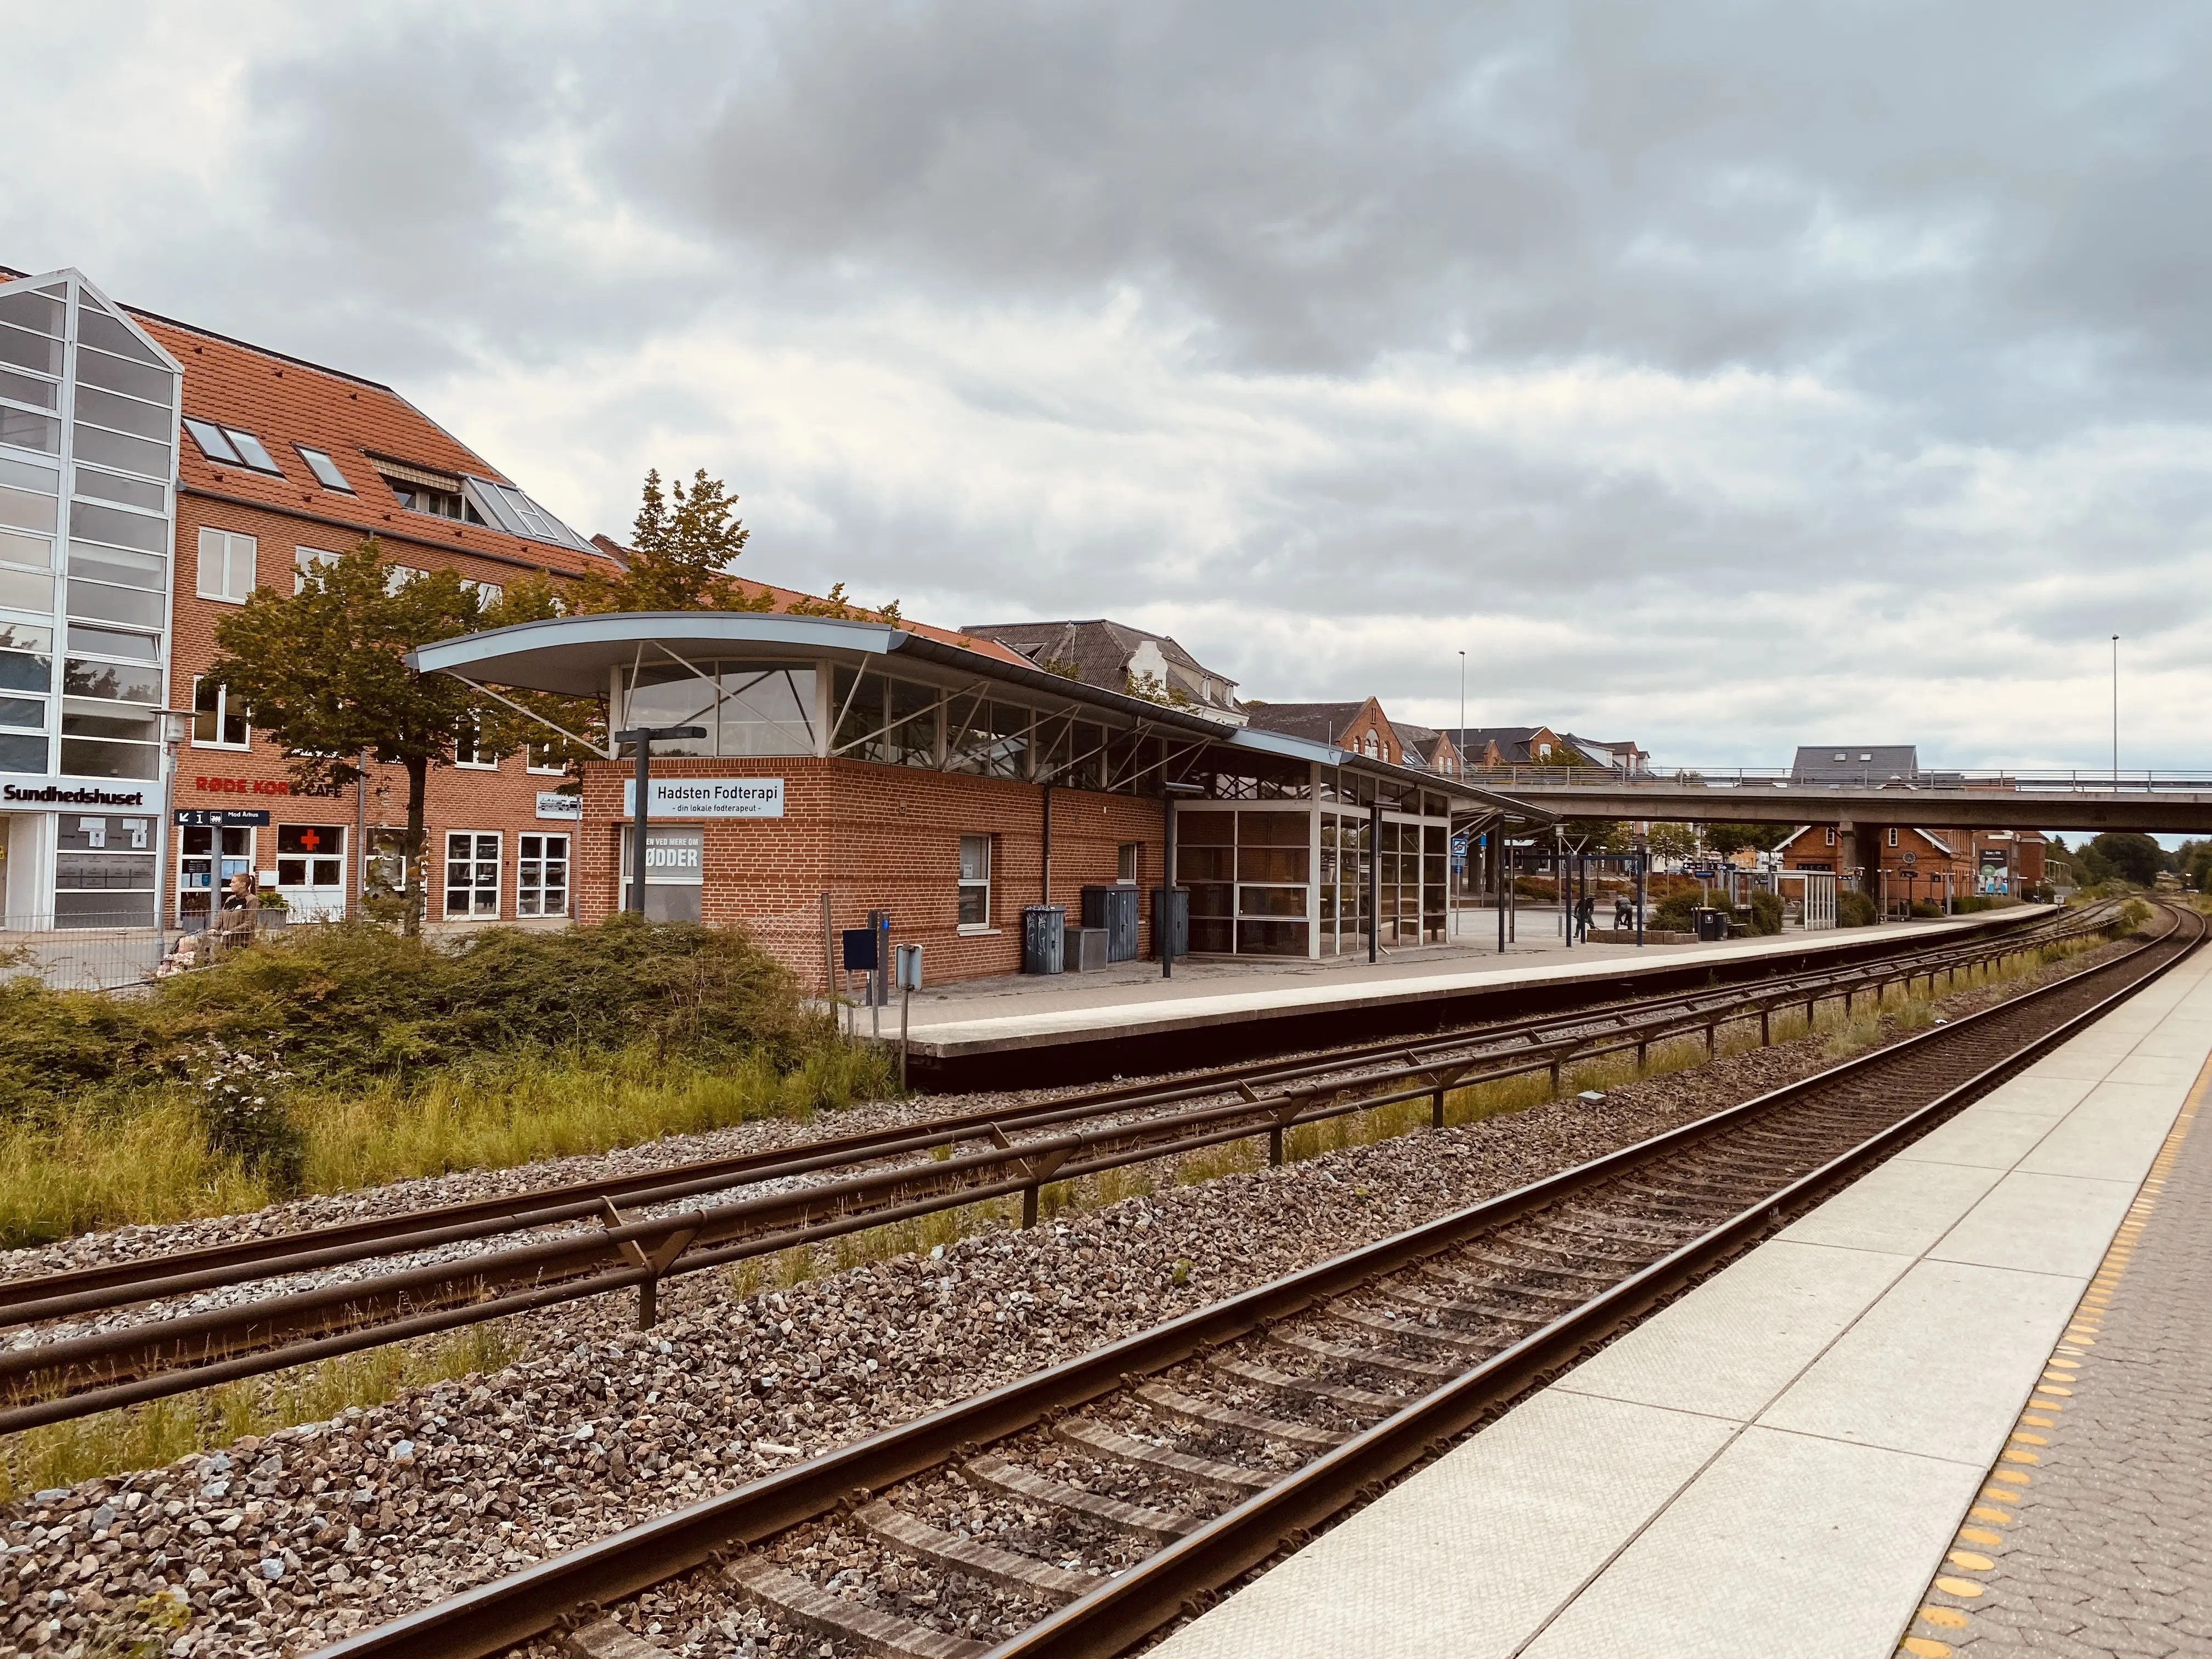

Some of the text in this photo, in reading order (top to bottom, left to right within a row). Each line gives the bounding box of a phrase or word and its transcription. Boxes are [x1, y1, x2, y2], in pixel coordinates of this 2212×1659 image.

[196, 776, 247, 793] RØDE
[253, 780, 289, 795] KOR
[658, 786, 777, 802] Hadsten Fodterapi
[4, 784, 143, 805] Sundhedshuset
[714, 804, 757, 813] fodterapeut
[196, 814, 203, 823] 1
[645, 848, 698, 867] ØDDER
